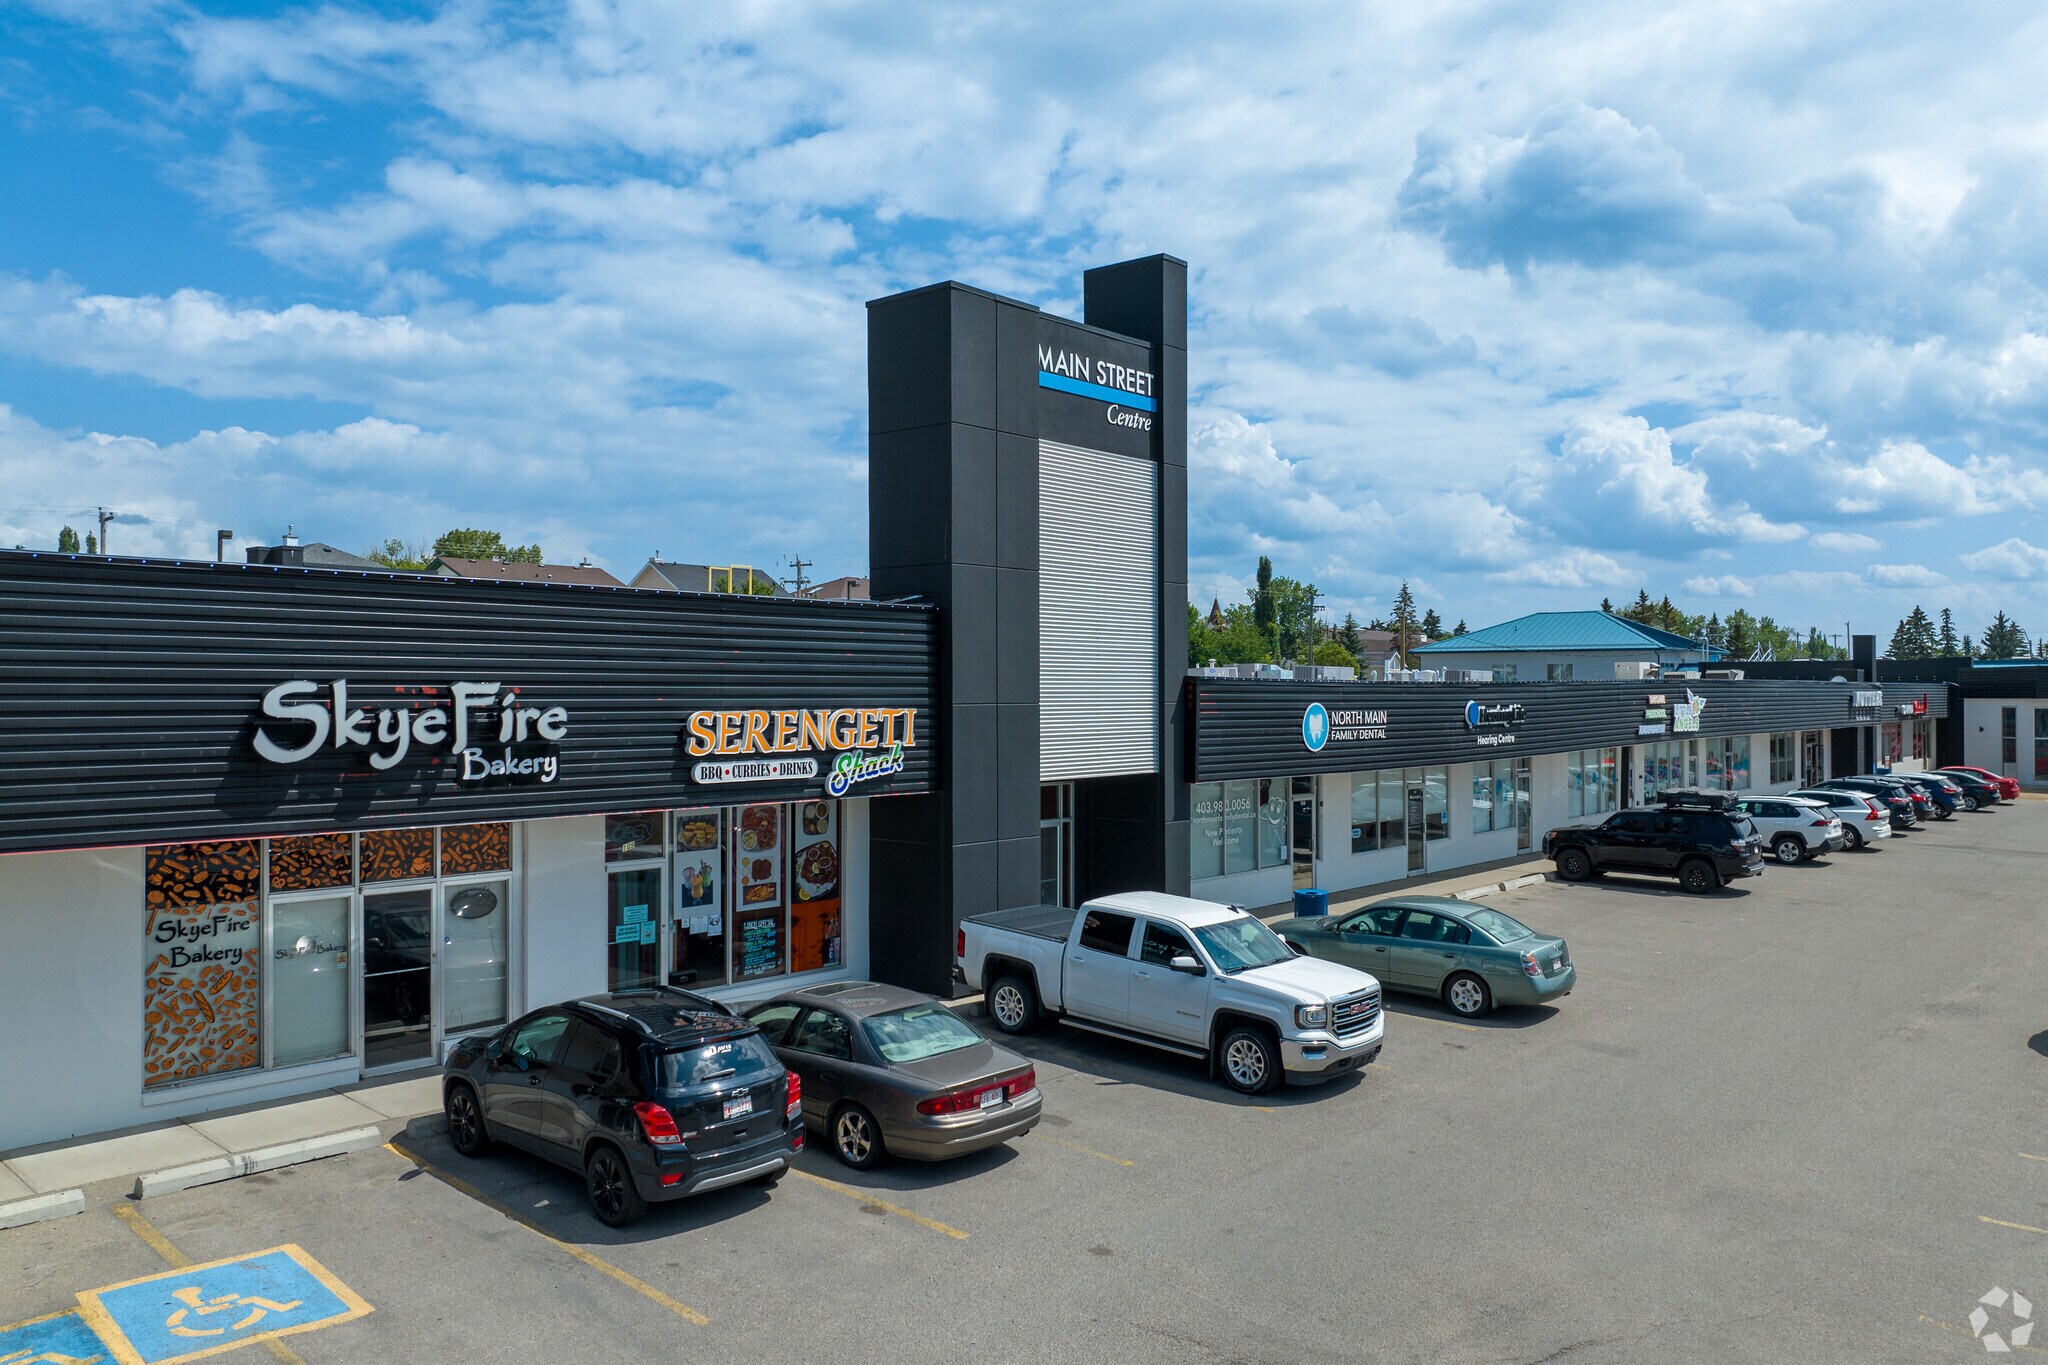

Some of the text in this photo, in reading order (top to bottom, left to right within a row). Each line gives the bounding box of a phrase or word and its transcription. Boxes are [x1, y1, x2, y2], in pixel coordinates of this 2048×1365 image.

[1038, 343, 1155, 396] MAIN STREET
[1107, 404, 1152, 431] Centre
[253, 679, 568, 770] SkyeFire
[1331, 710, 1387, 725] NORTH MAIN
[1674, 716, 1700, 732] ANGELS
[686, 708, 917, 756] SERENGETI
[1331, 729, 1386, 740] FAMILY DENTAL
[1477, 733, 1515, 746] Hearing Centre
[462, 748, 557, 782] Bakery
[700, 762, 813, 780] BBQ CURRIES DRINKS
[824, 740, 904, 796] Shack
[613, 824, 651, 840] OPEN
[1205, 829, 1218, 837] New
[1212, 837, 1240, 846] Welcome
[154, 915, 252, 944] SkyeFire
[170, 944, 244, 969] Bakery
[316, 943, 347, 954] Bakery
